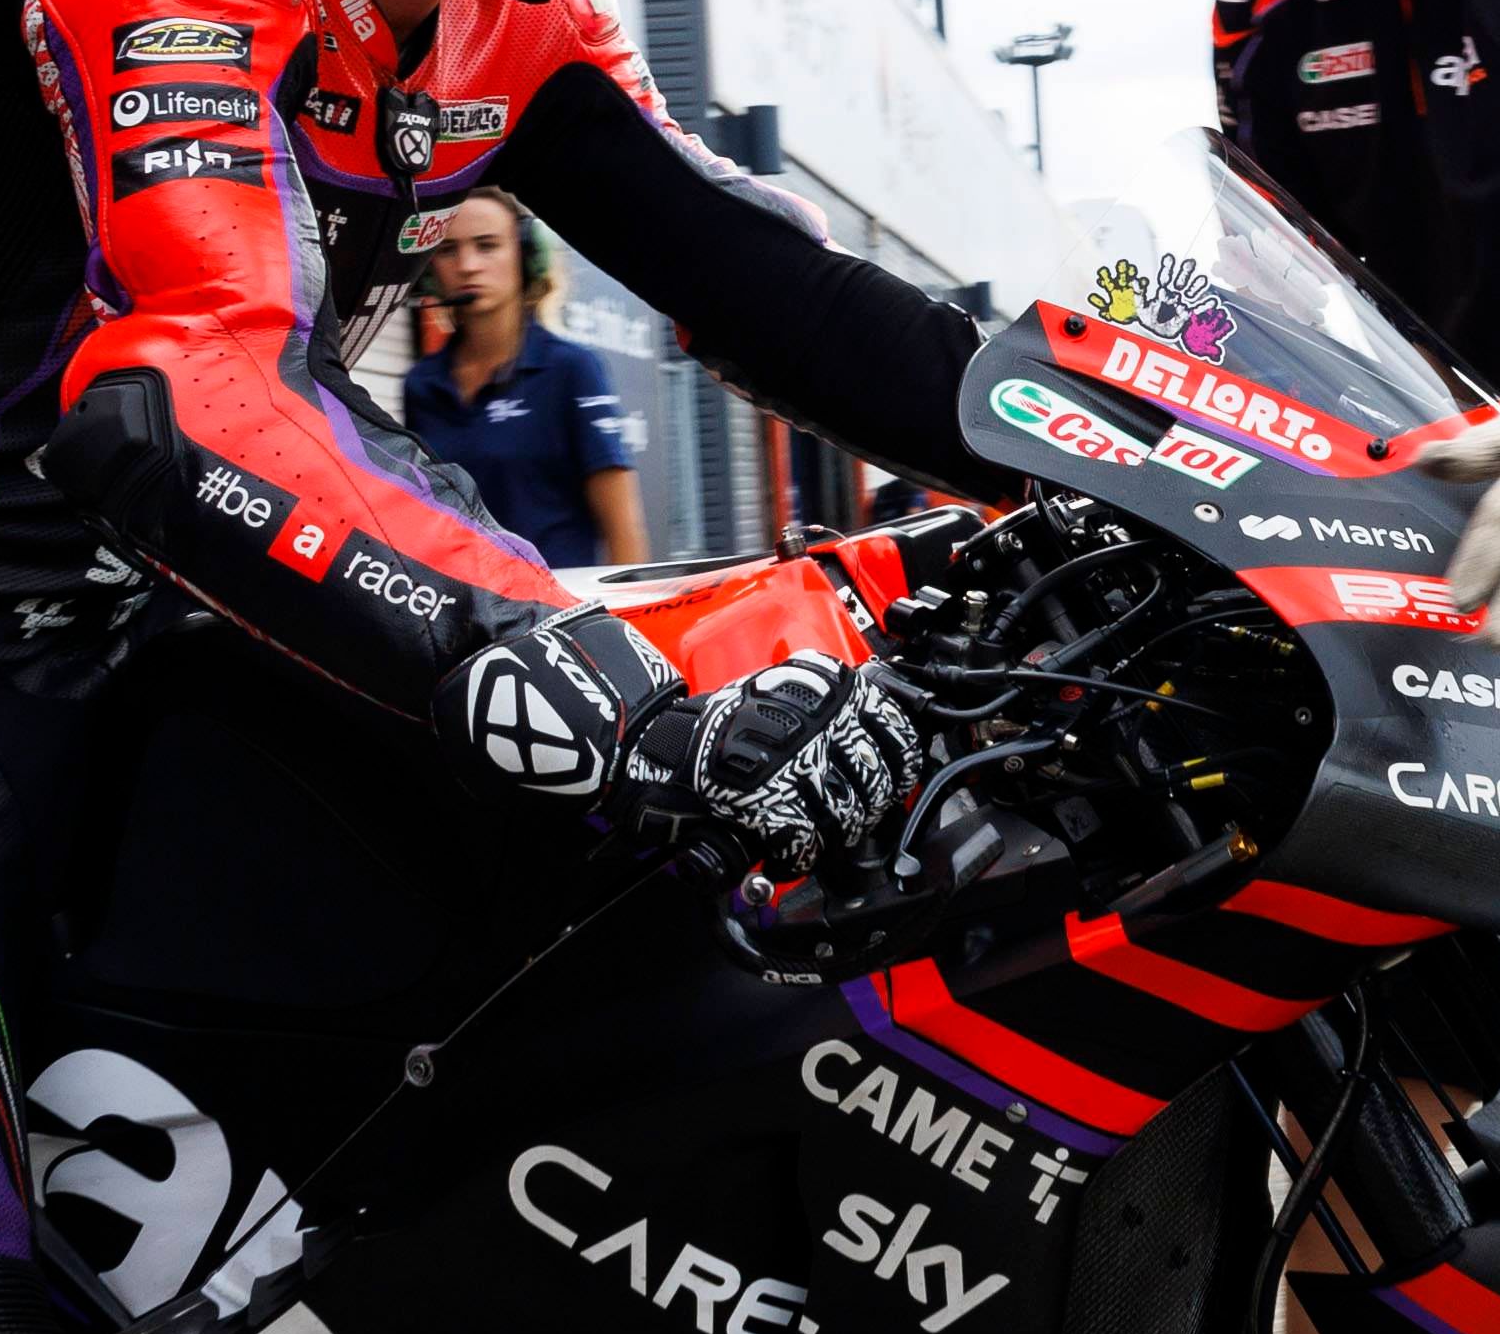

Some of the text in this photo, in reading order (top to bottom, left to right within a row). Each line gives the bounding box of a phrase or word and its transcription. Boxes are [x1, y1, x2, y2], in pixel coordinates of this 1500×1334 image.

[152, 90, 259, 123] Lifenet.it
[1047, 411, 1243, 482] Castrol
[196, 465, 273, 529] #be
[291, 523, 325, 560] a
[343, 547, 457, 622] racer
[1310, 517, 1436, 555] Marsh
[800, 1039, 1015, 1195] CAME
[822, 1192, 1011, 1334] sky
